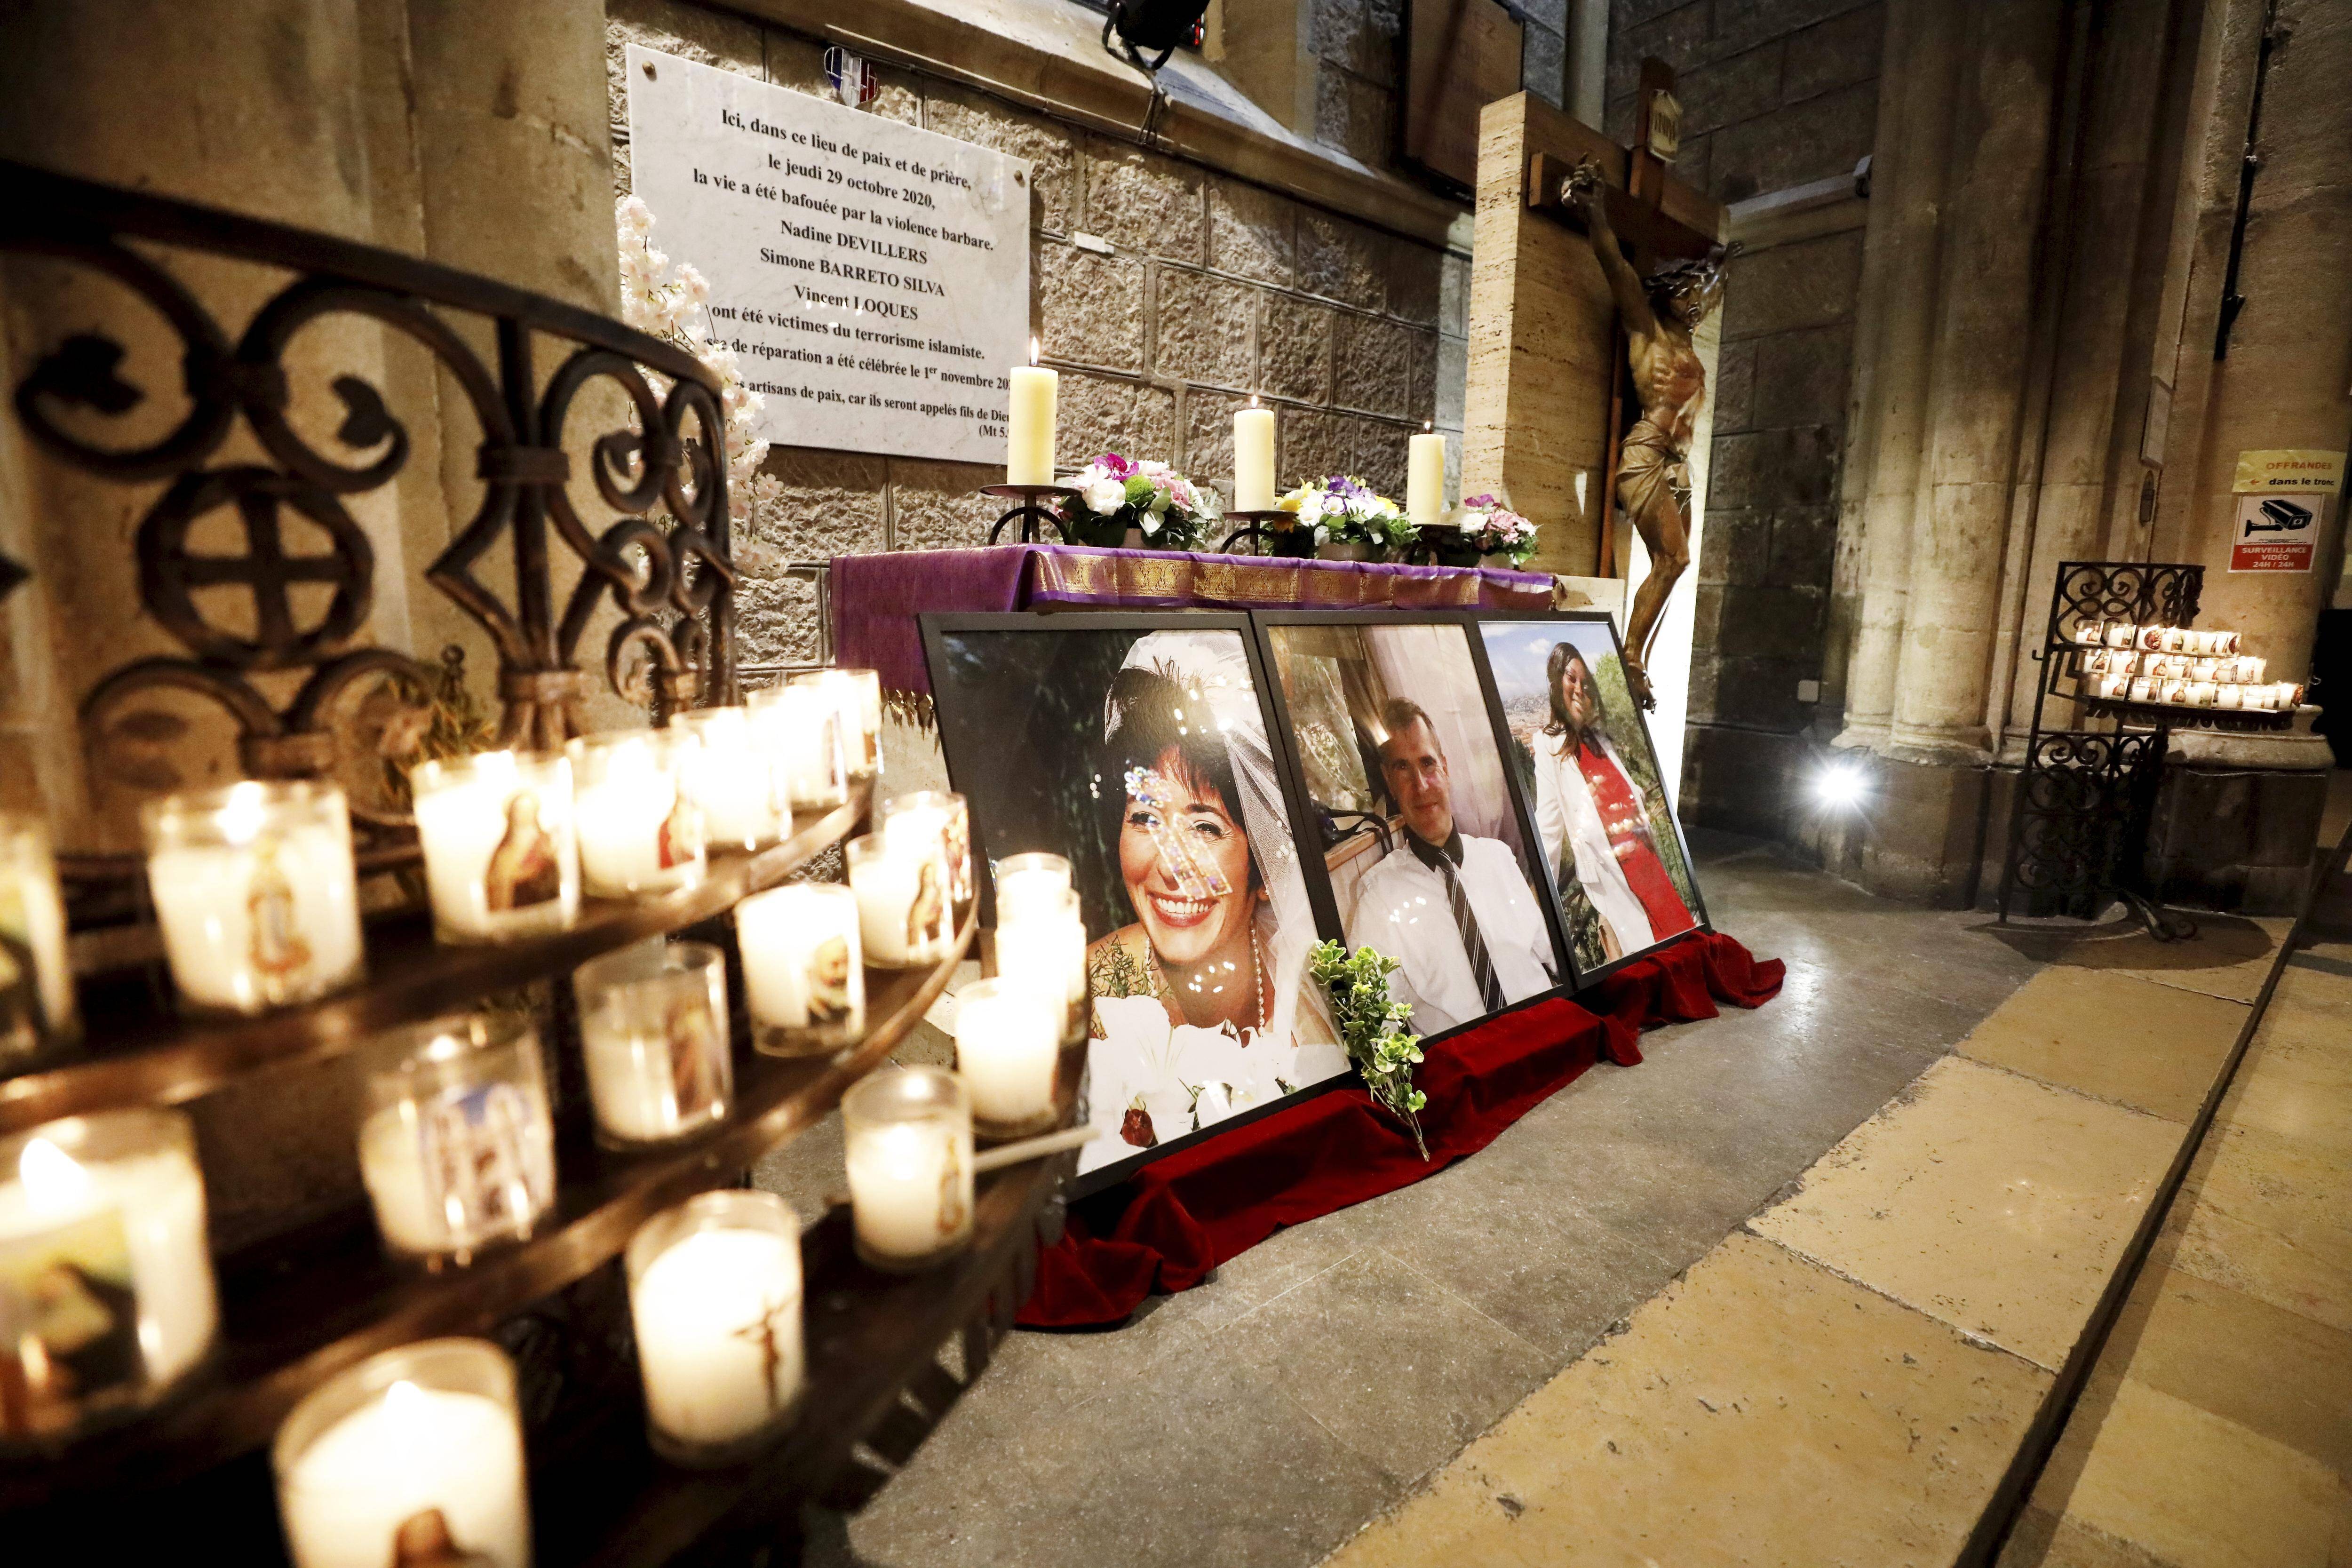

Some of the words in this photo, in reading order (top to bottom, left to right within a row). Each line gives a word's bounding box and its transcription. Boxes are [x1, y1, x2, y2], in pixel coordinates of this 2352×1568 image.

[722, 109, 745, 131] Ici,
[751, 119, 787, 140] dans
[792, 132, 806, 144] ce
[811, 134, 836, 153] lieu
[842, 143, 858, 158] de
[862, 150, 890, 167] paix
[896, 160, 907, 172] et
[912, 162, 926, 177] de
[930, 168, 971, 191] prière,
[769, 153, 780, 169] le
[785, 159, 822, 180] jeudi
[827, 169, 842, 184] 29
[847, 177, 898, 199] octobre
[902, 188, 935, 210] 2020,
[694, 168, 707, 184] la
[714, 175, 736, 191] vie
[741, 183, 750, 194] a
[755, 183, 777, 200] été
[782, 188, 837, 215] bafouée
[842, 207, 866, 221] par
[870, 210, 882, 225] la
[887, 215, 938, 238] violence
[942, 227, 993, 250] barbare.
[781, 220, 832, 244] Nadine
[837, 232, 928, 264] DEVILLERS
[760, 247, 815, 270] Simone
[820, 260, 899, 287] BARRETO
[904, 276, 945, 297] SILVA
[794, 285, 849, 308] Vincent
[854, 296, 918, 320] LOQUES
[712, 306, 737, 319] ont
[742, 307, 763, 323] été
[768, 313, 828, 334] victimes
[833, 323, 850, 338] du
[856, 328, 924, 350] terrorisme
[929, 339, 985, 359] islamiste.
[732, 338, 747, 353] de
[752, 342, 822, 364] réparation
[826, 355, 833, 365] a
[837, 354, 855, 368] été
[859, 358, 907, 375] célébrée
[910, 365, 920, 378] le
[924, 366, 938, 379] 1er
[941, 372, 993, 388] novembre
[997, 377, 1010, 390] 20
[749, 381, 796, 397] artisans
[800, 385, 813, 398] de
[818, 389, 845, 405] paix,
[849, 394, 866, 405] car
[869, 394, 881, 407] ils
[884, 398, 917, 411] seront
[920, 403, 957, 417] appelés
[960, 406, 974, 418] fils
[977, 408, 988, 420] de
[979, 424, 997, 438] (Mt
[1000, 427, 1009, 438] 5.
